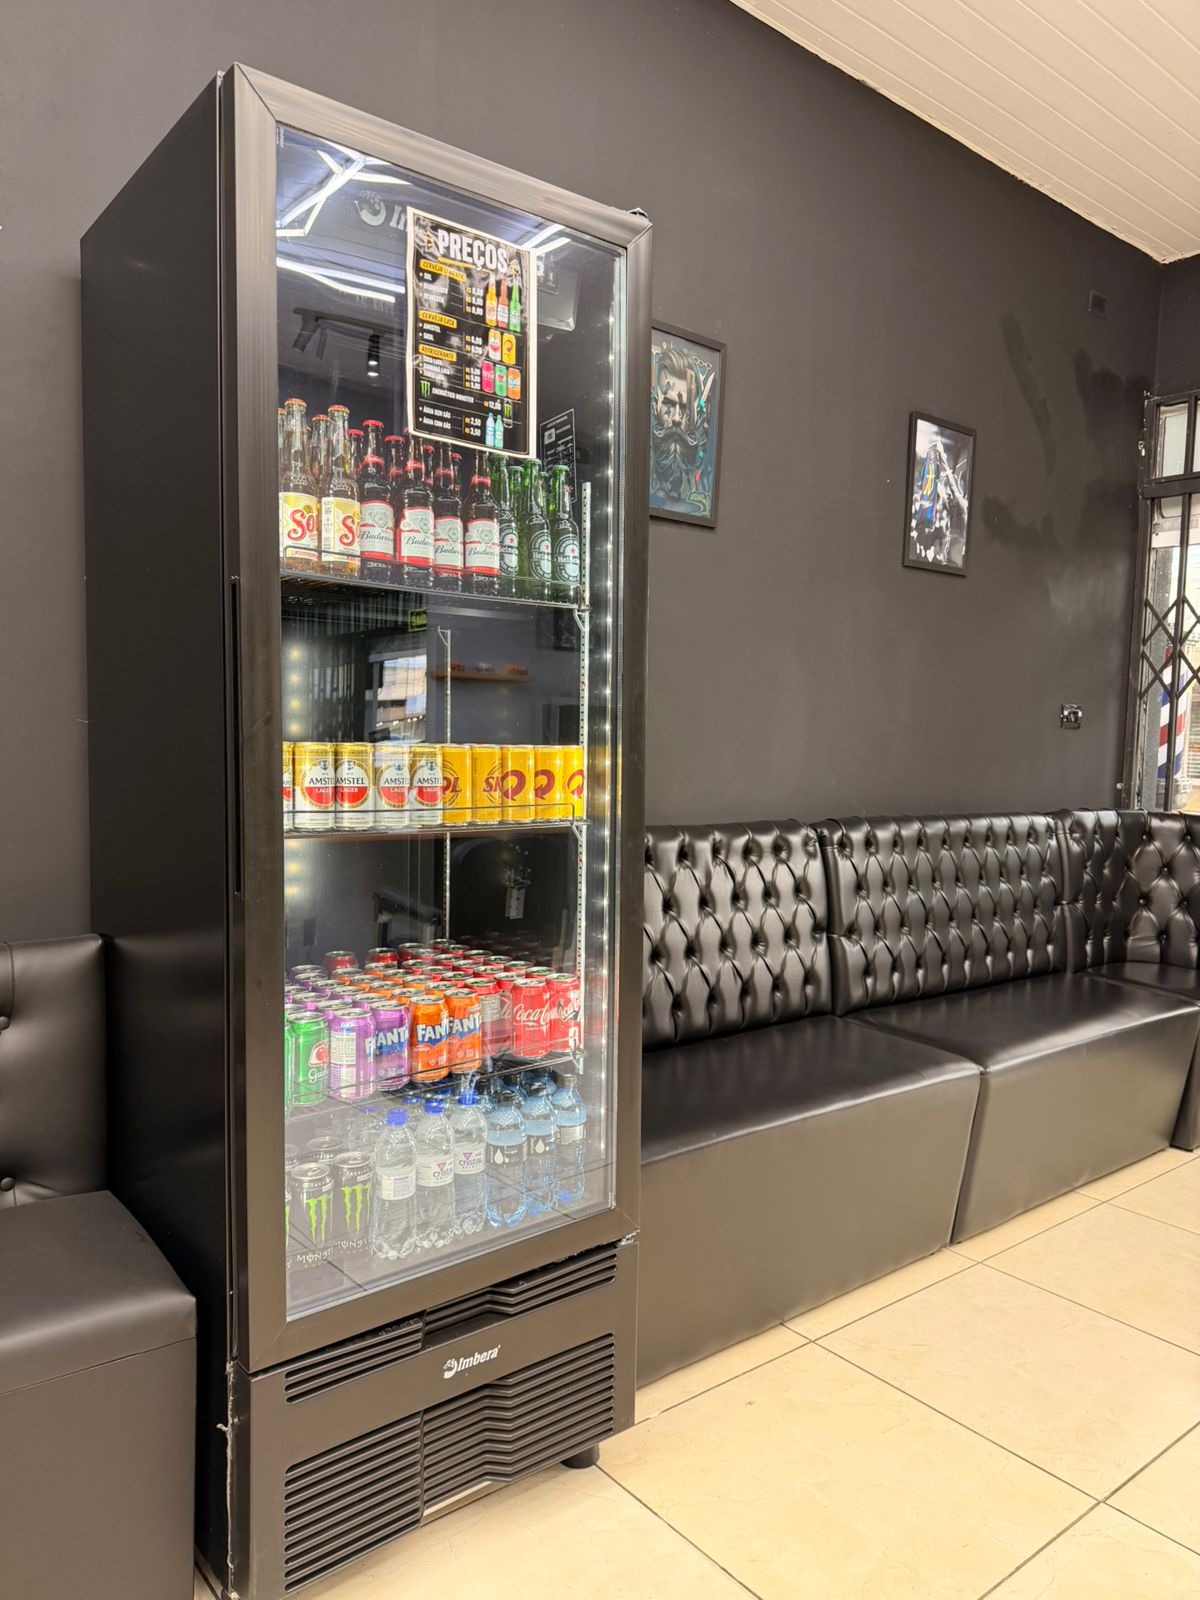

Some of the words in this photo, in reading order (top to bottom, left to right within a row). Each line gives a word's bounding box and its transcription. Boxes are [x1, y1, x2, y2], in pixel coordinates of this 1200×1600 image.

[437, 229, 508, 274] PREÇOS
[422, 260, 443, 272] CERVEJA
[422, 311, 443, 322] CERVEJA
[443, 316, 455, 326] LATA
[424, 322, 441, 333] AMSTEL
[421, 345, 455, 359] REFRIGERANTE
[455, 392, 474, 403] MONSTER
[423, 404, 433, 414] ÁGUA
[433, 408, 442, 416] SEM
[443, 410, 451, 419] GÁS
[423, 415, 433, 425] ÁGUA
[433, 419, 442, 427] COM
[443, 420, 451, 430] GÁS
[336, 777, 366, 785] AMSTEL
[456, 1346, 500, 1372] Imbera
